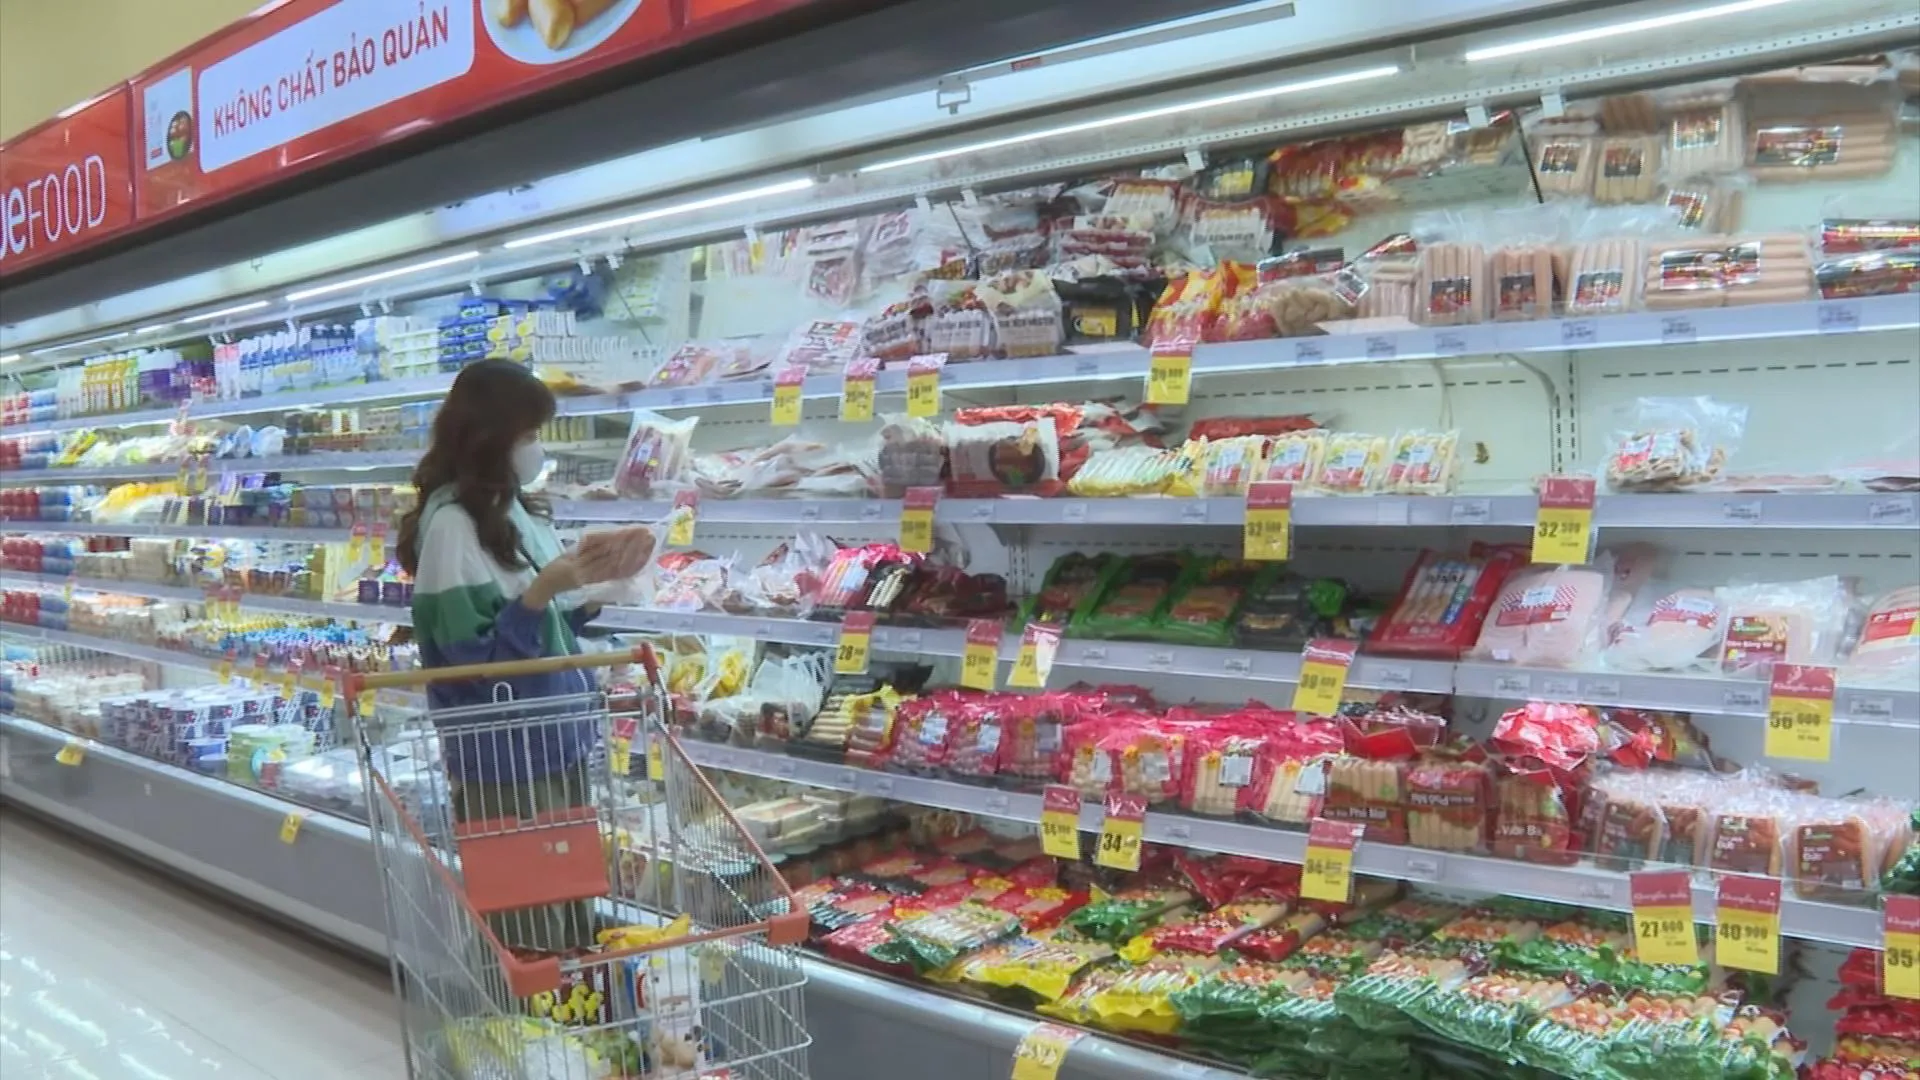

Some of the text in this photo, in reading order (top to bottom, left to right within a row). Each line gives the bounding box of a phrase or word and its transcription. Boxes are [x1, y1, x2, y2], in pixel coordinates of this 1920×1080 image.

[213, 1, 449, 139] KHÔNG CHẤT BẢO QUẢN
[1537, 521, 1558, 538] 32
[1103, 833, 1122, 852] 34
[1640, 921, 1660, 938] 27
[1719, 923, 1743, 940] 40
[1888, 948, 1913, 968] 35
